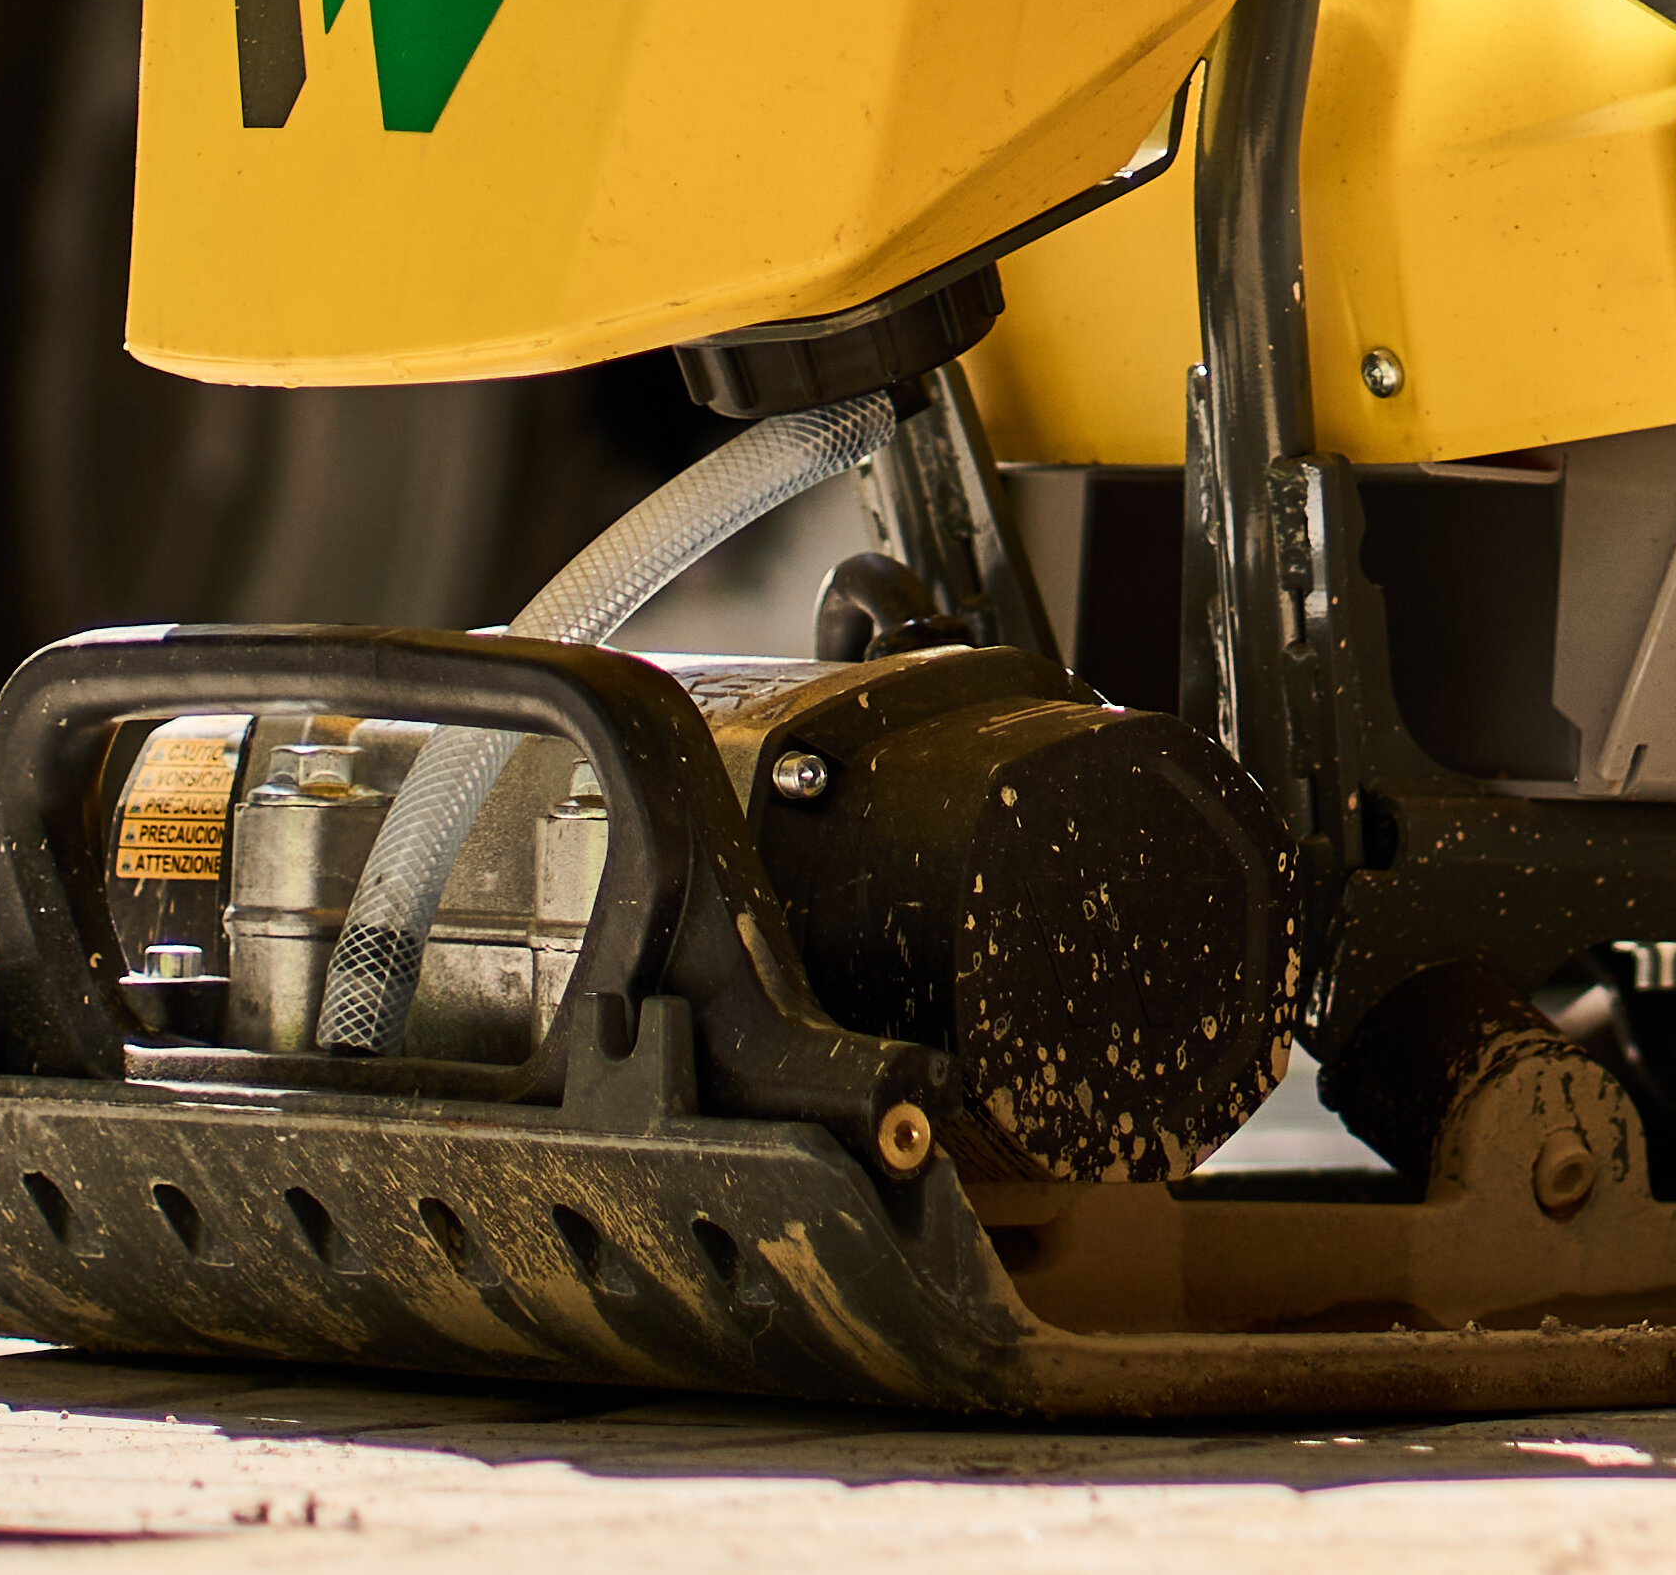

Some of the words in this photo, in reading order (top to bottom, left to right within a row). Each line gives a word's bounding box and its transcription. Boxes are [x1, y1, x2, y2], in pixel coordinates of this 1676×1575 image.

[167, 743, 224, 762] CAUTIO
[157, 770, 233, 788] VORSICHT
[144, 797, 226, 815] PRECAUCIO
